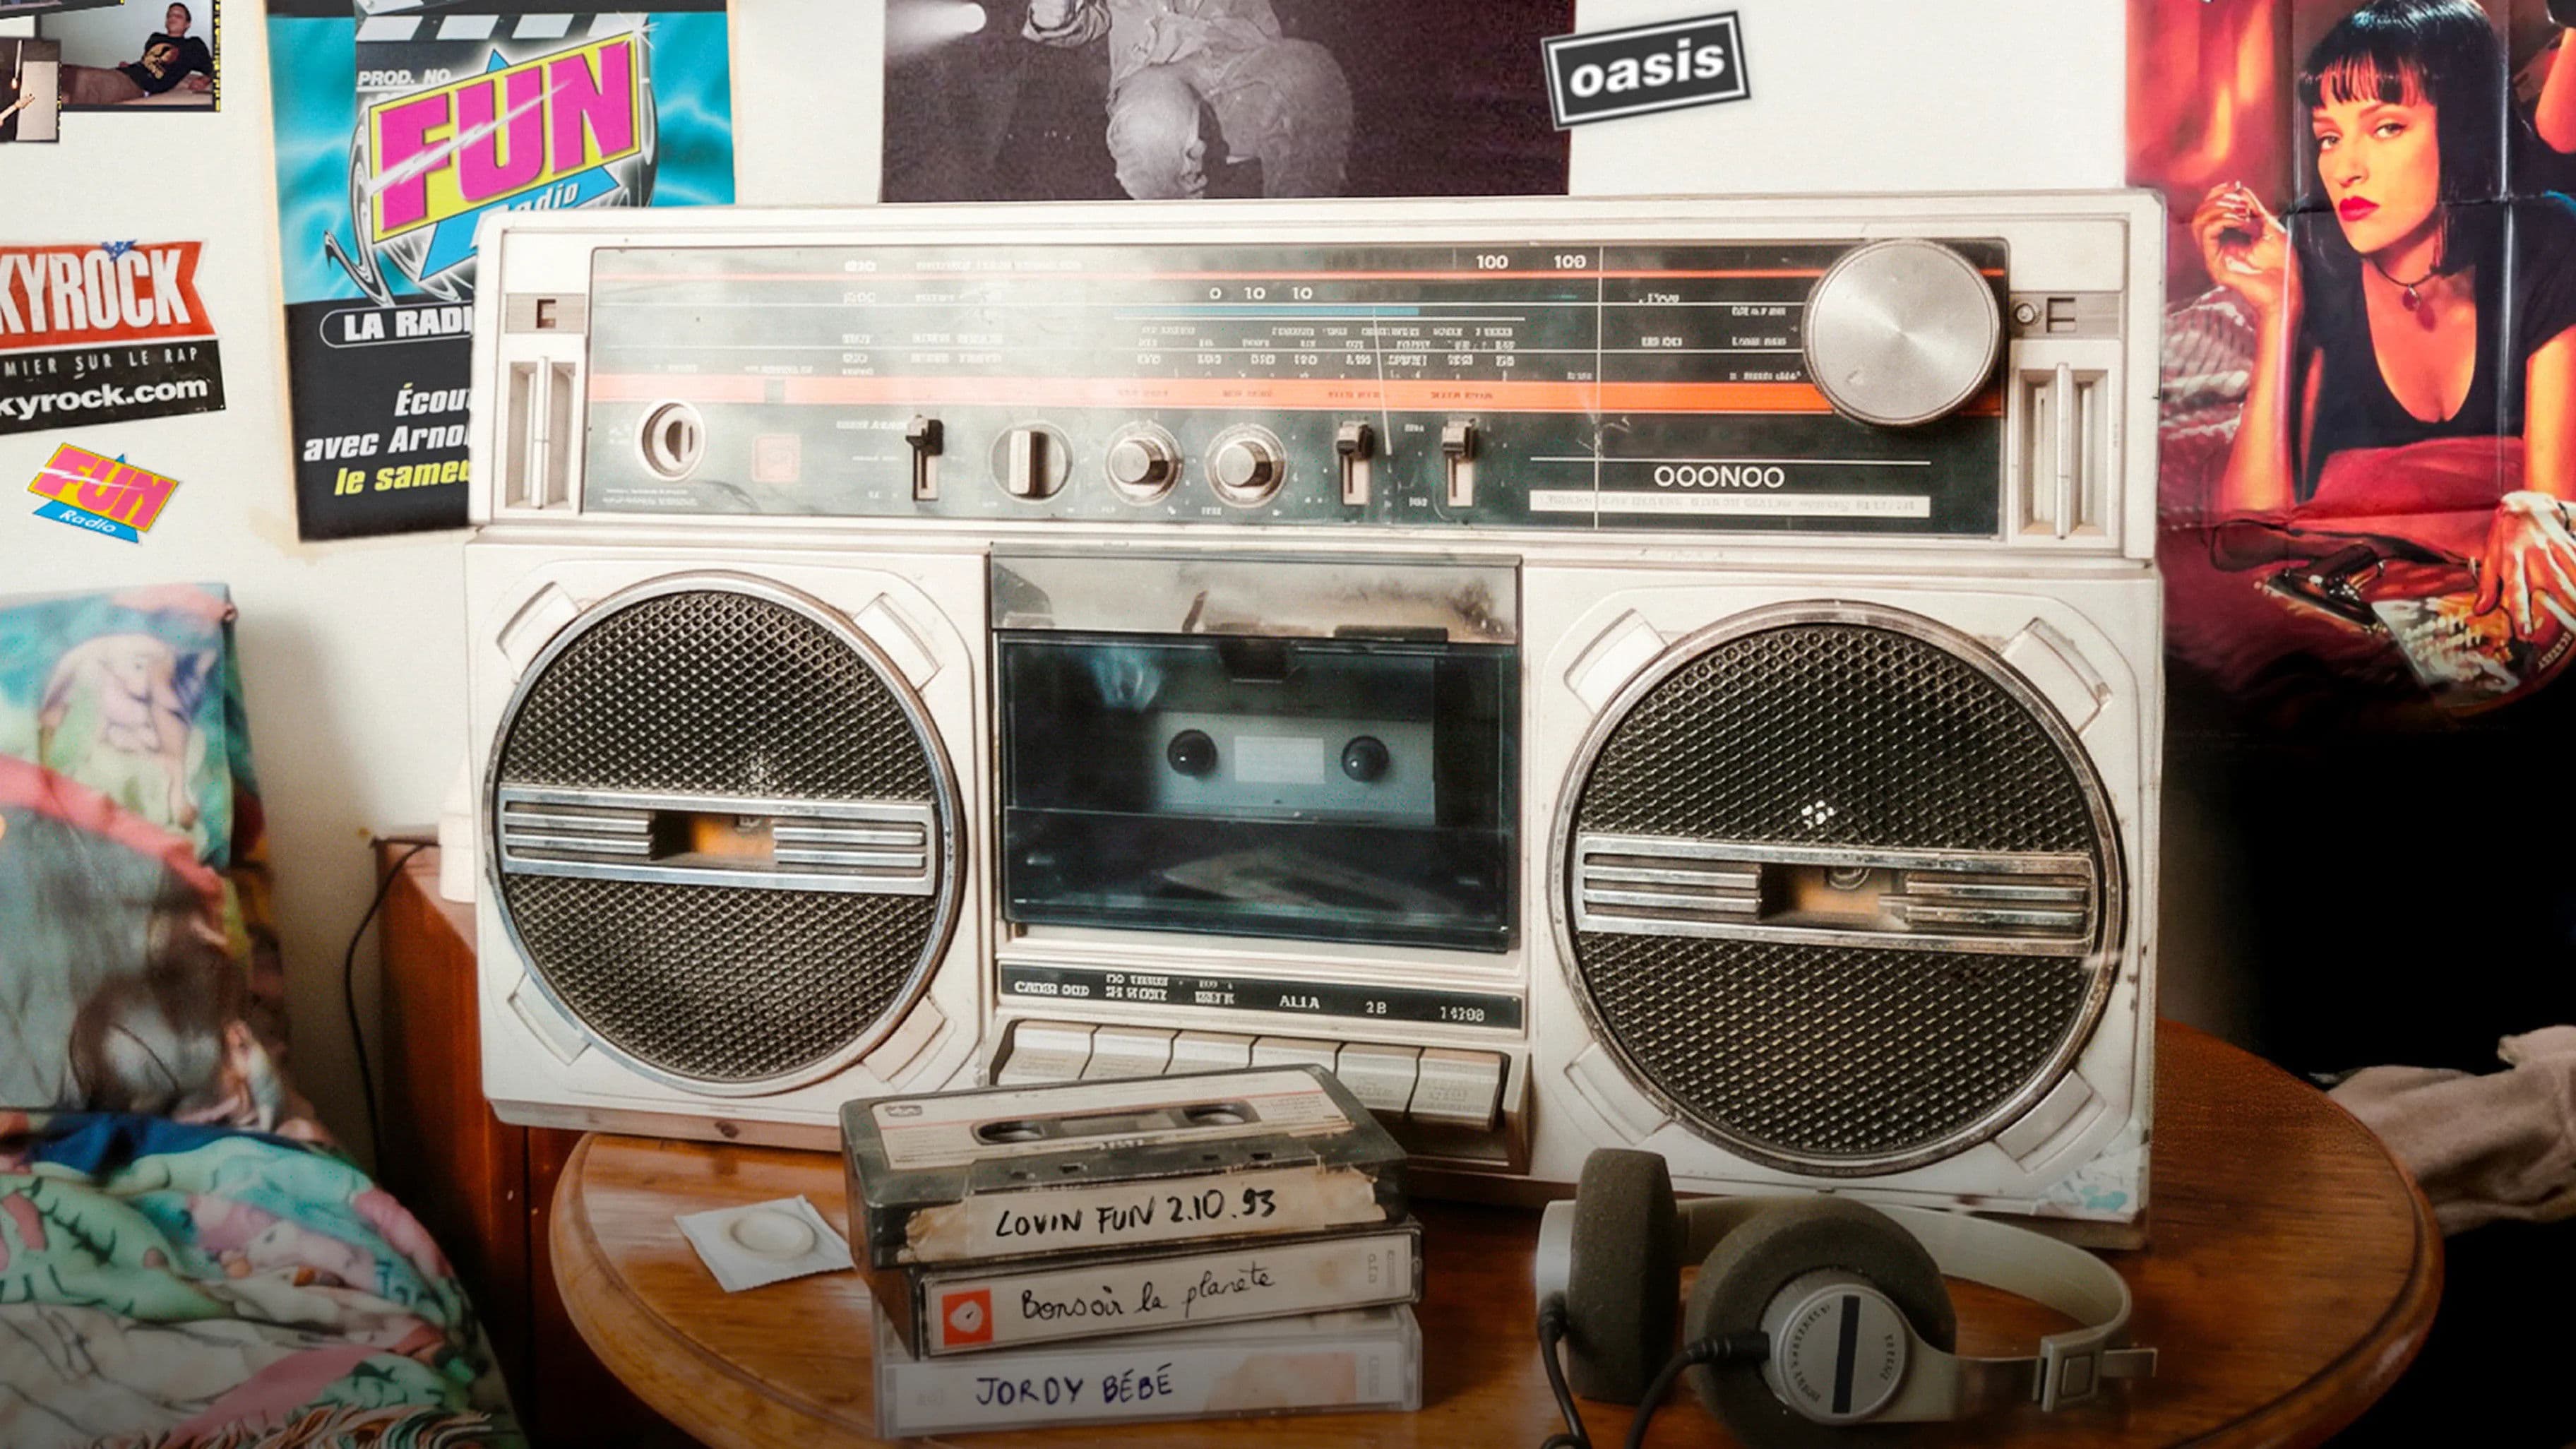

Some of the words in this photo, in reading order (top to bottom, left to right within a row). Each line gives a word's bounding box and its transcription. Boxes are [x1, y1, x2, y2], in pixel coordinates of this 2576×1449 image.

[358, 70, 415, 86] PROD.
[1570, 37, 1725, 97] oasis
[378, 41, 636, 233] FUN
[1476, 254, 1509, 270] 100
[1554, 254, 1587, 270] 100
[1244, 287, 1266, 300] 10
[1293, 287, 1313, 300] 10
[344, 312, 385, 341] LA
[76, 354, 112, 371] SUR
[130, 350, 149, 367] LE
[165, 347, 198, 363] RAP
[303, 433, 380, 462] avec
[33, 447, 174, 528] FUN
[334, 467, 366, 496] le
[1654, 465, 1785, 488] OOONOO
[59, 510, 116, 532] Radio
[996, 1208, 1082, 1237] LOVIN
[1096, 1195, 1156, 1234] FUN
[1021, 1285, 1125, 1320] Bonsoir
[1133, 1281, 1169, 1312] la
[976, 1377, 1084, 1405] JORDY
[1102, 1362, 1173, 1404] BÉBÉ
